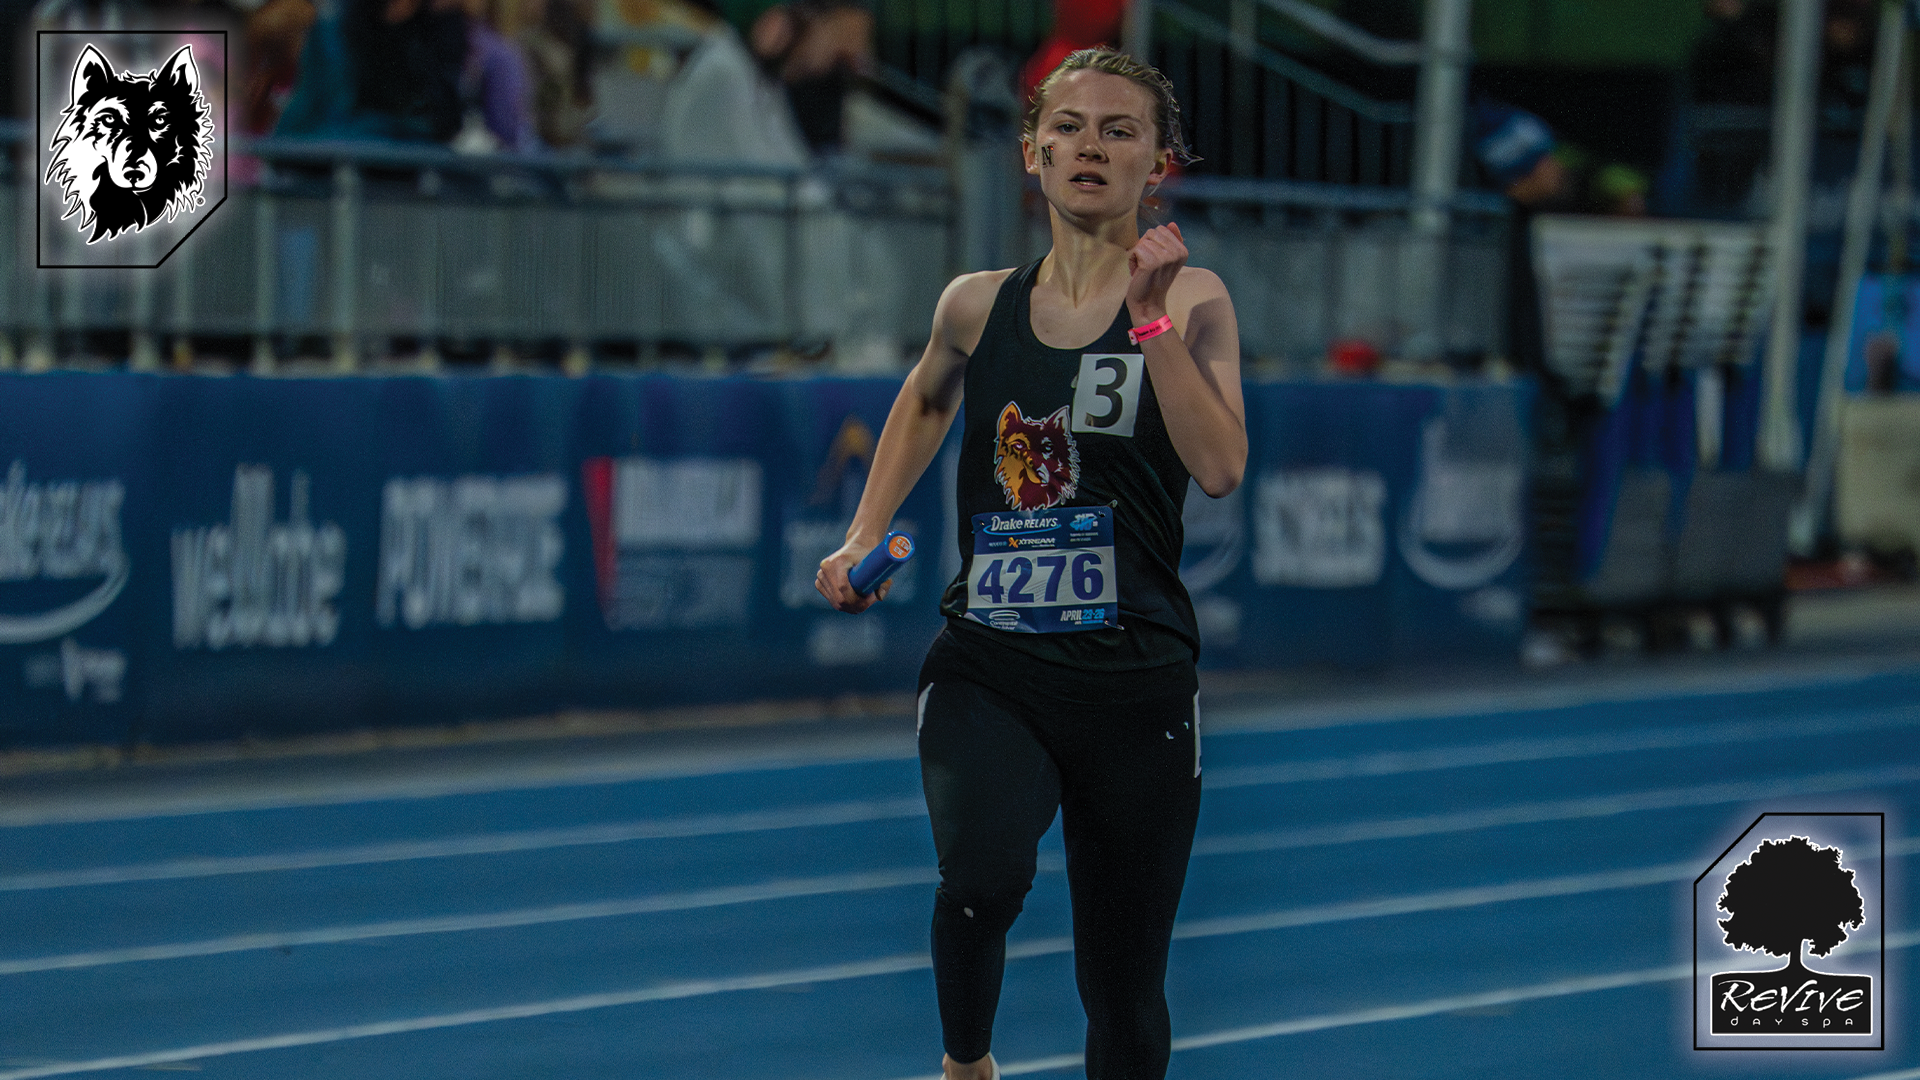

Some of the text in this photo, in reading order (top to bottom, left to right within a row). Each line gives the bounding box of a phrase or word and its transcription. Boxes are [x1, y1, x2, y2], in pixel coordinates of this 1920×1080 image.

[1085, 357, 1128, 428] 3
[990, 515, 1023, 532] Drake
[1024, 518, 1058, 528] RELAYS
[977, 553, 1103, 603] 4276
[1060, 610, 1082, 621] APRIL
